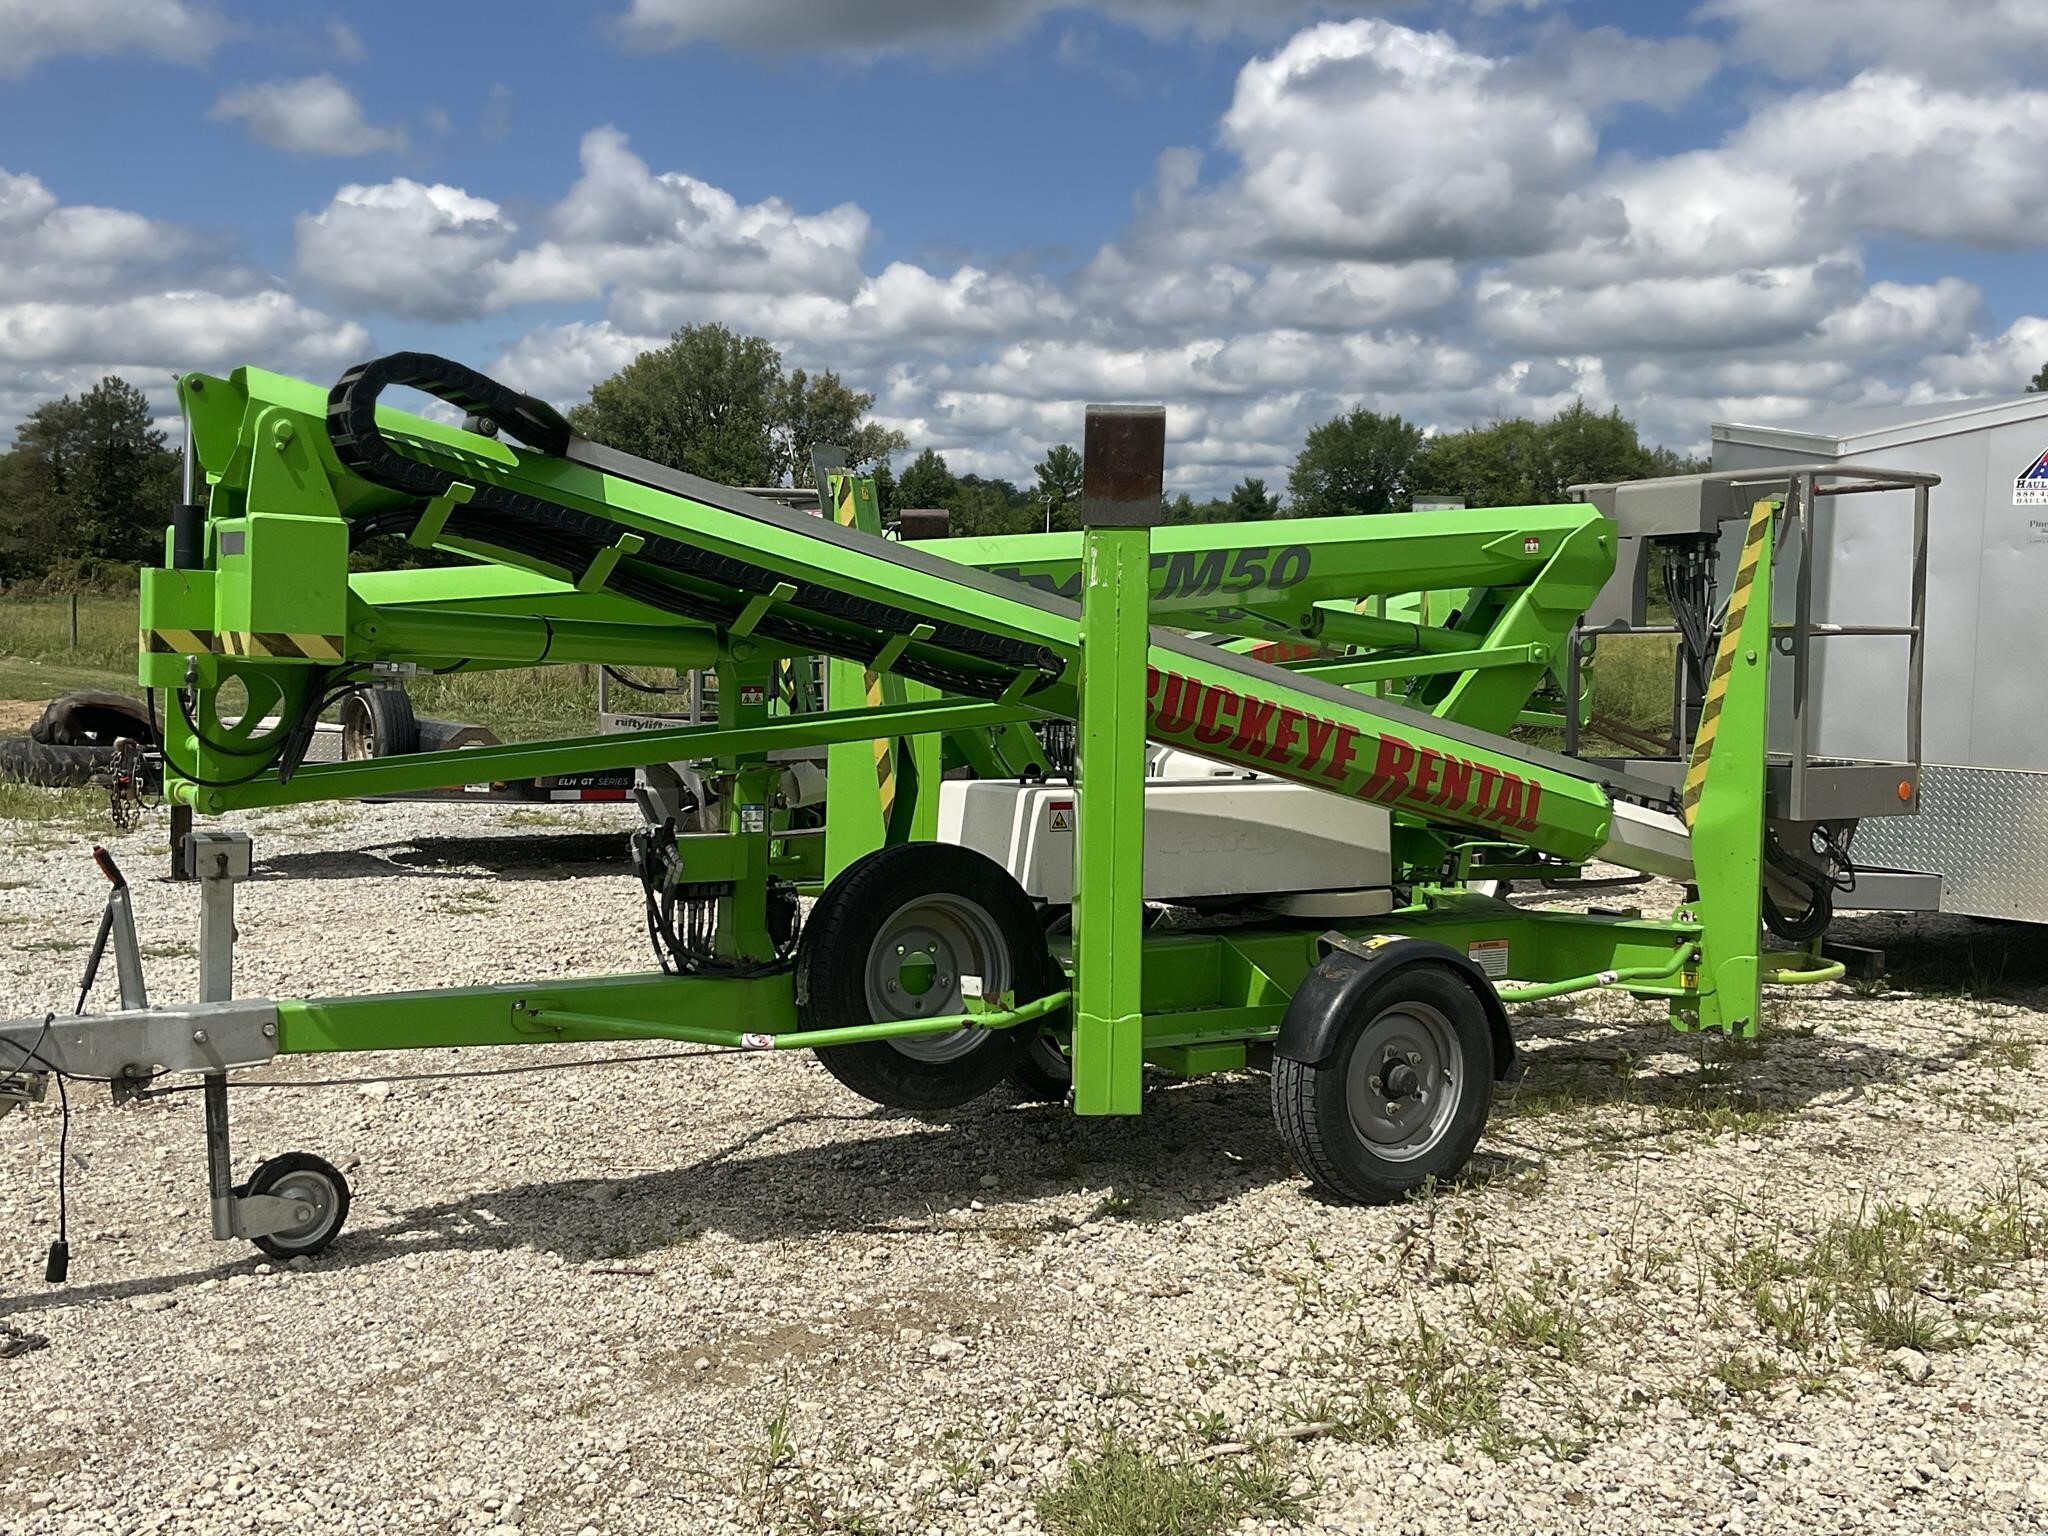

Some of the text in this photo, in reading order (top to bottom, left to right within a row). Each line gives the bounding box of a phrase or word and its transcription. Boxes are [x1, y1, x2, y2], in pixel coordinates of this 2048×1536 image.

[558, 777, 629, 786] ELH GT SERIES
[1358, 733, 1542, 832] RENTAL
